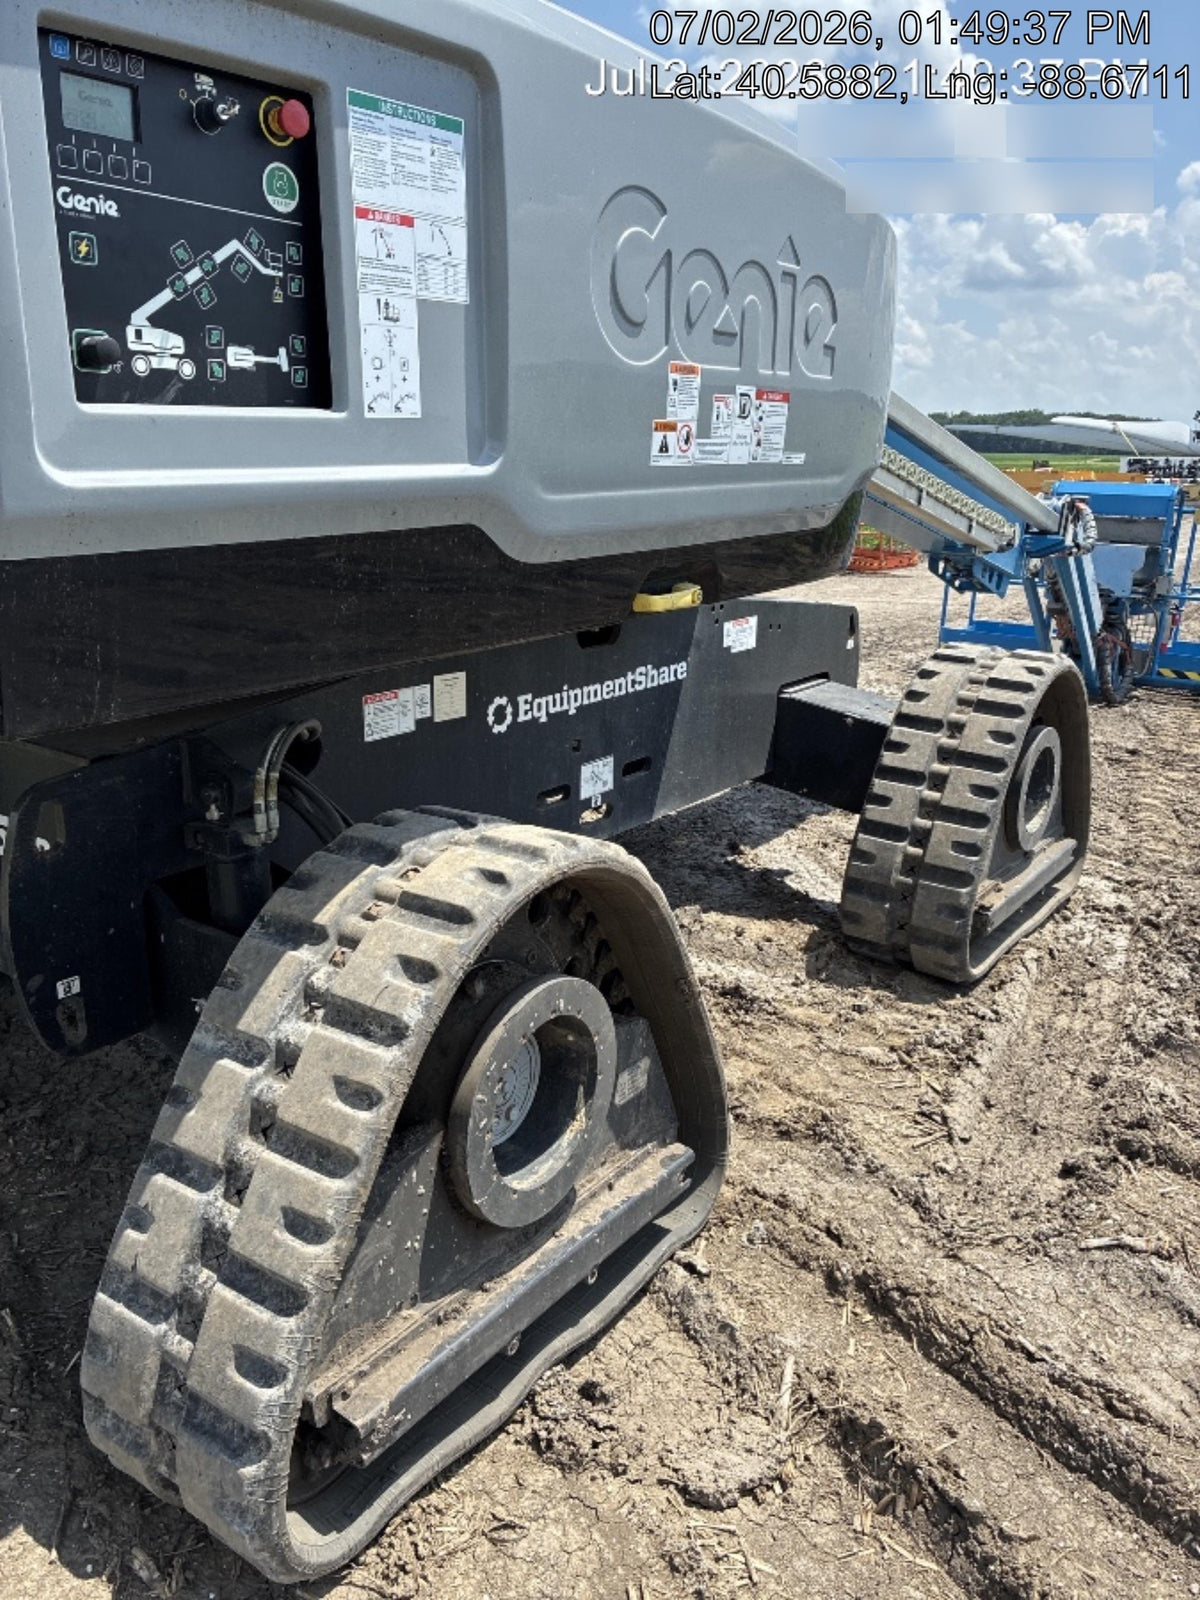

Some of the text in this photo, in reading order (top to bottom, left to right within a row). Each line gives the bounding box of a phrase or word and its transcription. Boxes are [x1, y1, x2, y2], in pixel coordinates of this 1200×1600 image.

[378, 100, 437, 127] INSTRUCTIONS
[56, 186, 119, 217] Genie
[590, 184, 838, 379] Genie
[516, 660, 688, 723] EquipmentShare
